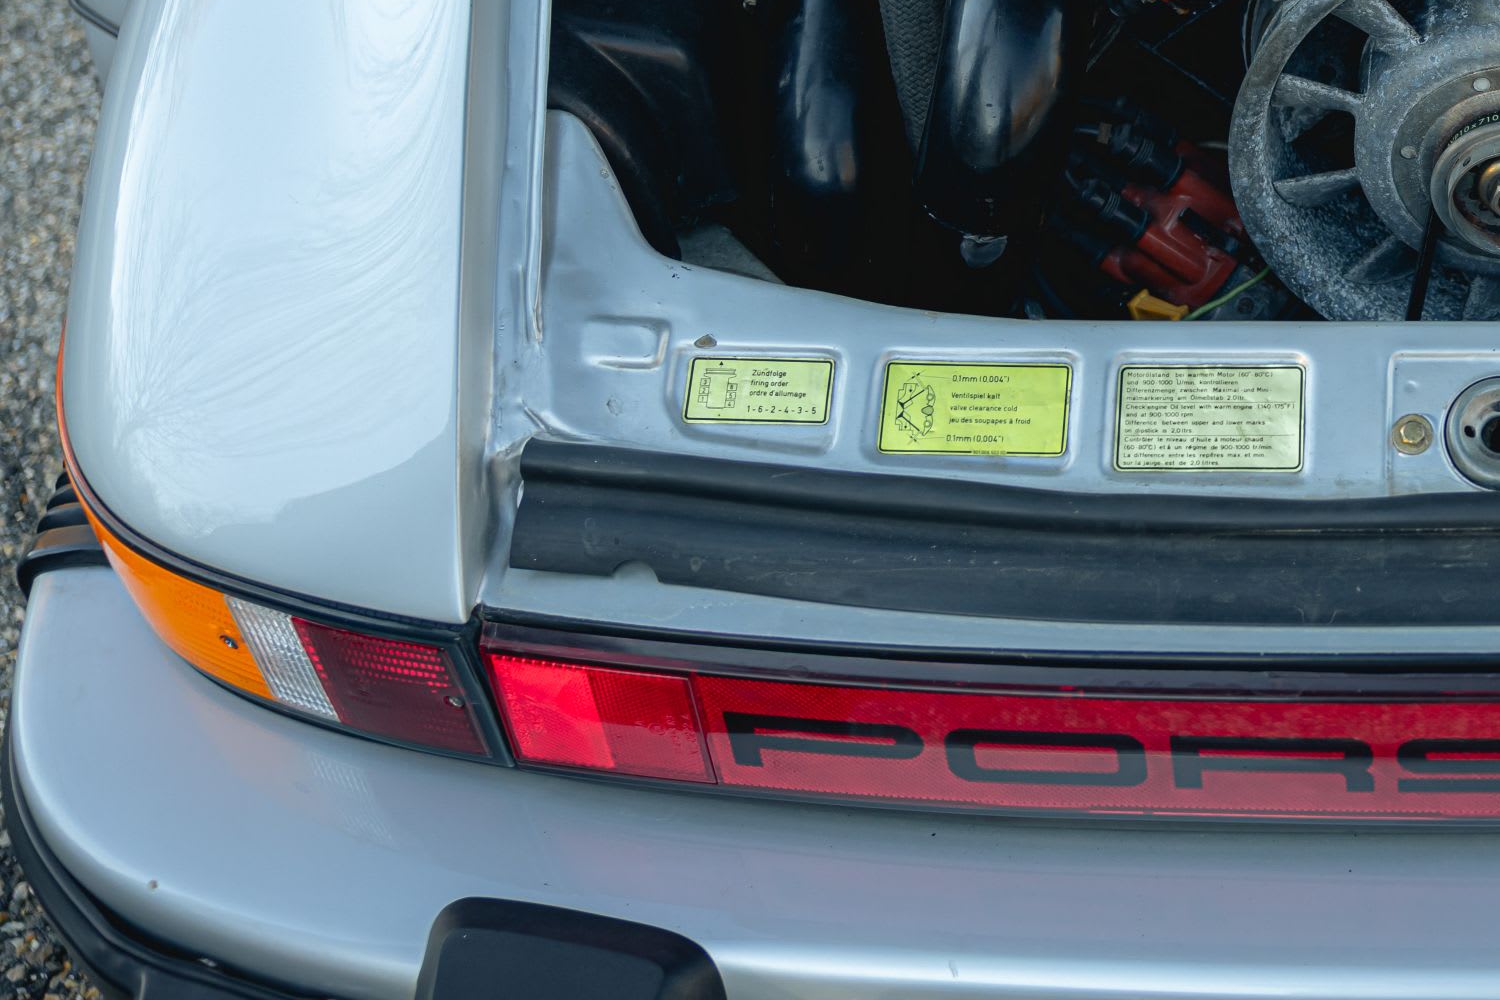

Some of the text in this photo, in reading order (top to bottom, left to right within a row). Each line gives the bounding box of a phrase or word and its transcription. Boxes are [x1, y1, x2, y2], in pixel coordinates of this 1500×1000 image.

[1479, 114, 1499, 126] 710
[752, 368, 787, 378] Zündfolge
[750, 379, 769, 388] firing
[749, 389, 807, 398] ordre d'allumage
[951, 392, 986, 400] Ventilspiel
